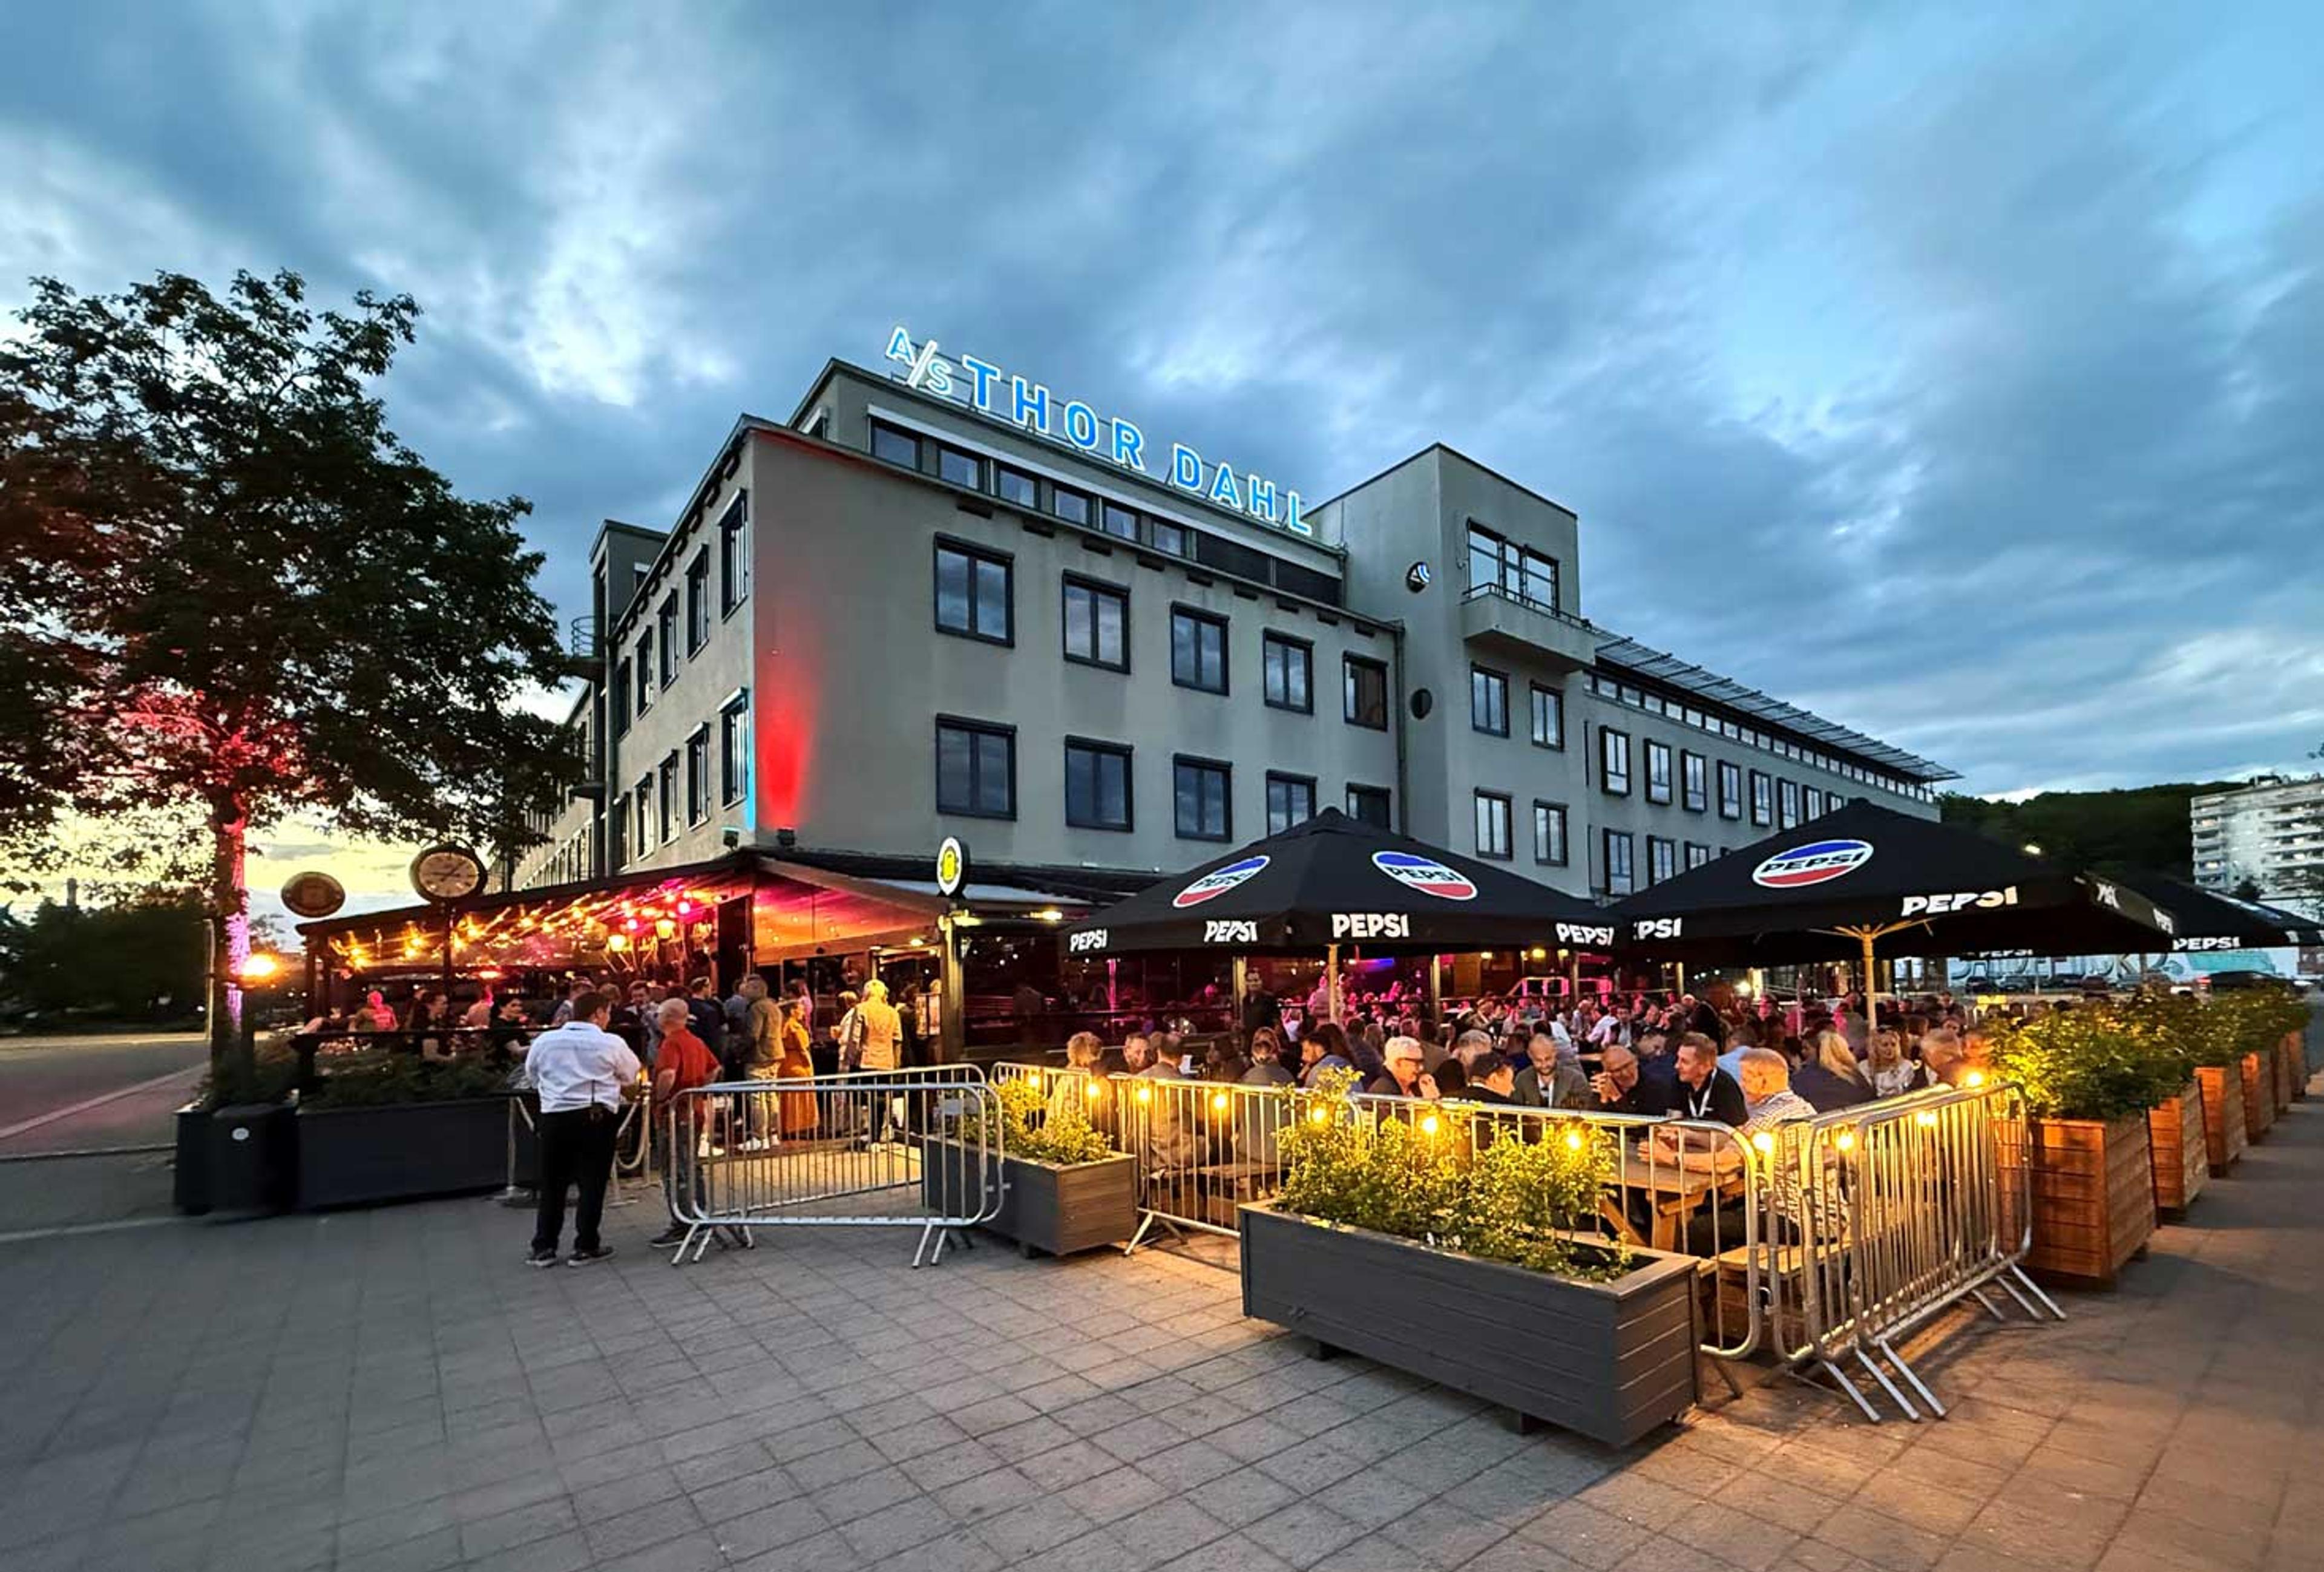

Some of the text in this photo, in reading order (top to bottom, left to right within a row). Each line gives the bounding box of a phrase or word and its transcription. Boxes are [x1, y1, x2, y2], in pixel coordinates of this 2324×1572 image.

[886, 326, 1312, 536] A/S THOR DAHL
[1761, 851, 1866, 873] PEPSI
[1384, 866, 1464, 882] PEPSI
[1204, 920, 1258, 942] PEPSI
[1331, 913, 1410, 938] PEPSI
[1555, 923, 1615, 946] PEPSI
[1633, 917, 1682, 940] PSI
[1069, 928, 1108, 952] PEPSI
[2172, 937, 2241, 951] PEPSI
